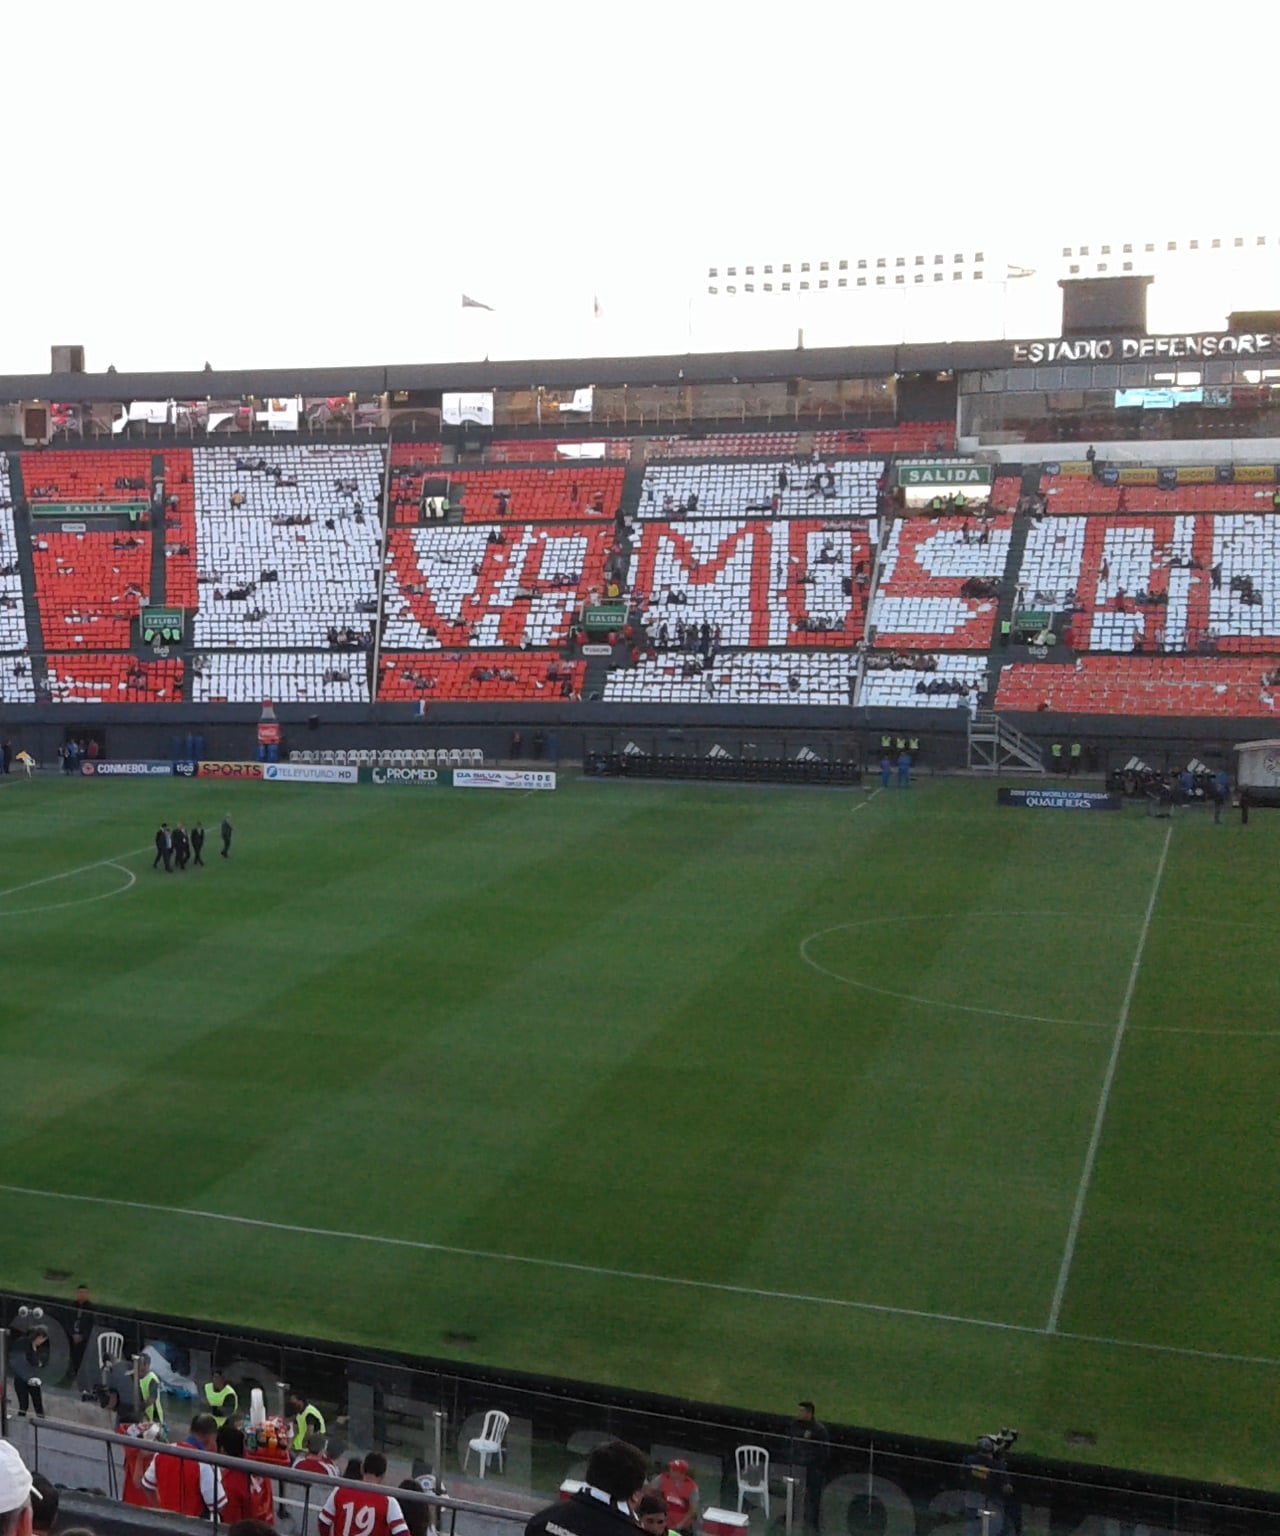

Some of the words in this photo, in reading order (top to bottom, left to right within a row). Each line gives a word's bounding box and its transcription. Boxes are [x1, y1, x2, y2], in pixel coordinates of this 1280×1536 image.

[1013, 340, 1113, 362] ESTADIO
[909, 470, 980, 482] SALIDA
[65, 504, 112, 512] SALIDA
[589, 615, 623, 623] SALIDA
[97, 763, 171, 775] CONMEBOL.com
[202, 763, 262, 777] SPORTS
[338, 771, 352, 779] HD
[386, 767, 438, 780] PROMED
[1041, 791, 1067, 799] WORLD
[1025, 797, 1092, 809] QUALIFIERS
[342, 1501, 376, 1536] 19
